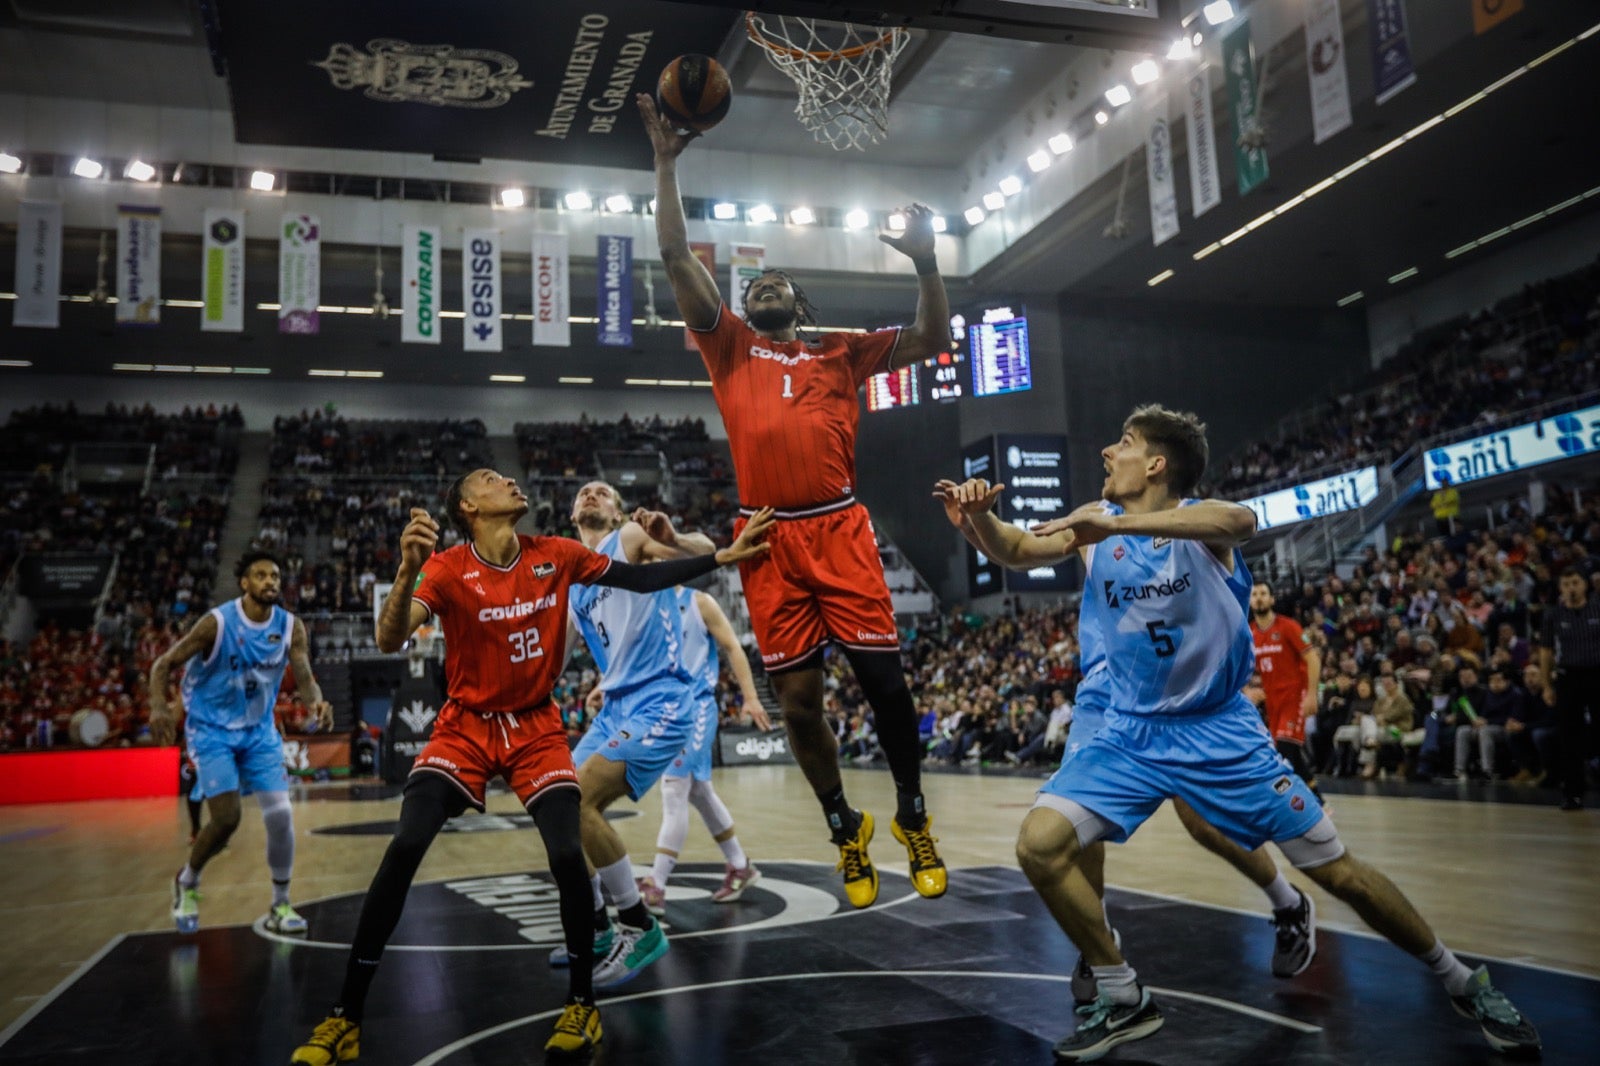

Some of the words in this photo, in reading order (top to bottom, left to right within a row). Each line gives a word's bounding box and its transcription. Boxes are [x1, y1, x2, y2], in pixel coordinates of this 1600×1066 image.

[534, 13, 609, 139] AYUNTAMIENTO
[588, 30, 654, 112] GRANADA
[588, 115, 617, 134] DE
[471, 238, 493, 319] asisa
[605, 237, 621, 288] Motor
[538, 256, 552, 323] RICOH
[604, 290, 620, 332] Mica
[782, 374, 794, 398] 1
[1458, 436, 1518, 481] añil
[1315, 474, 1361, 513] añil
[1121, 573, 1191, 601] zunder
[508, 627, 544, 664] 32
[1146, 620, 1174, 657] 5
